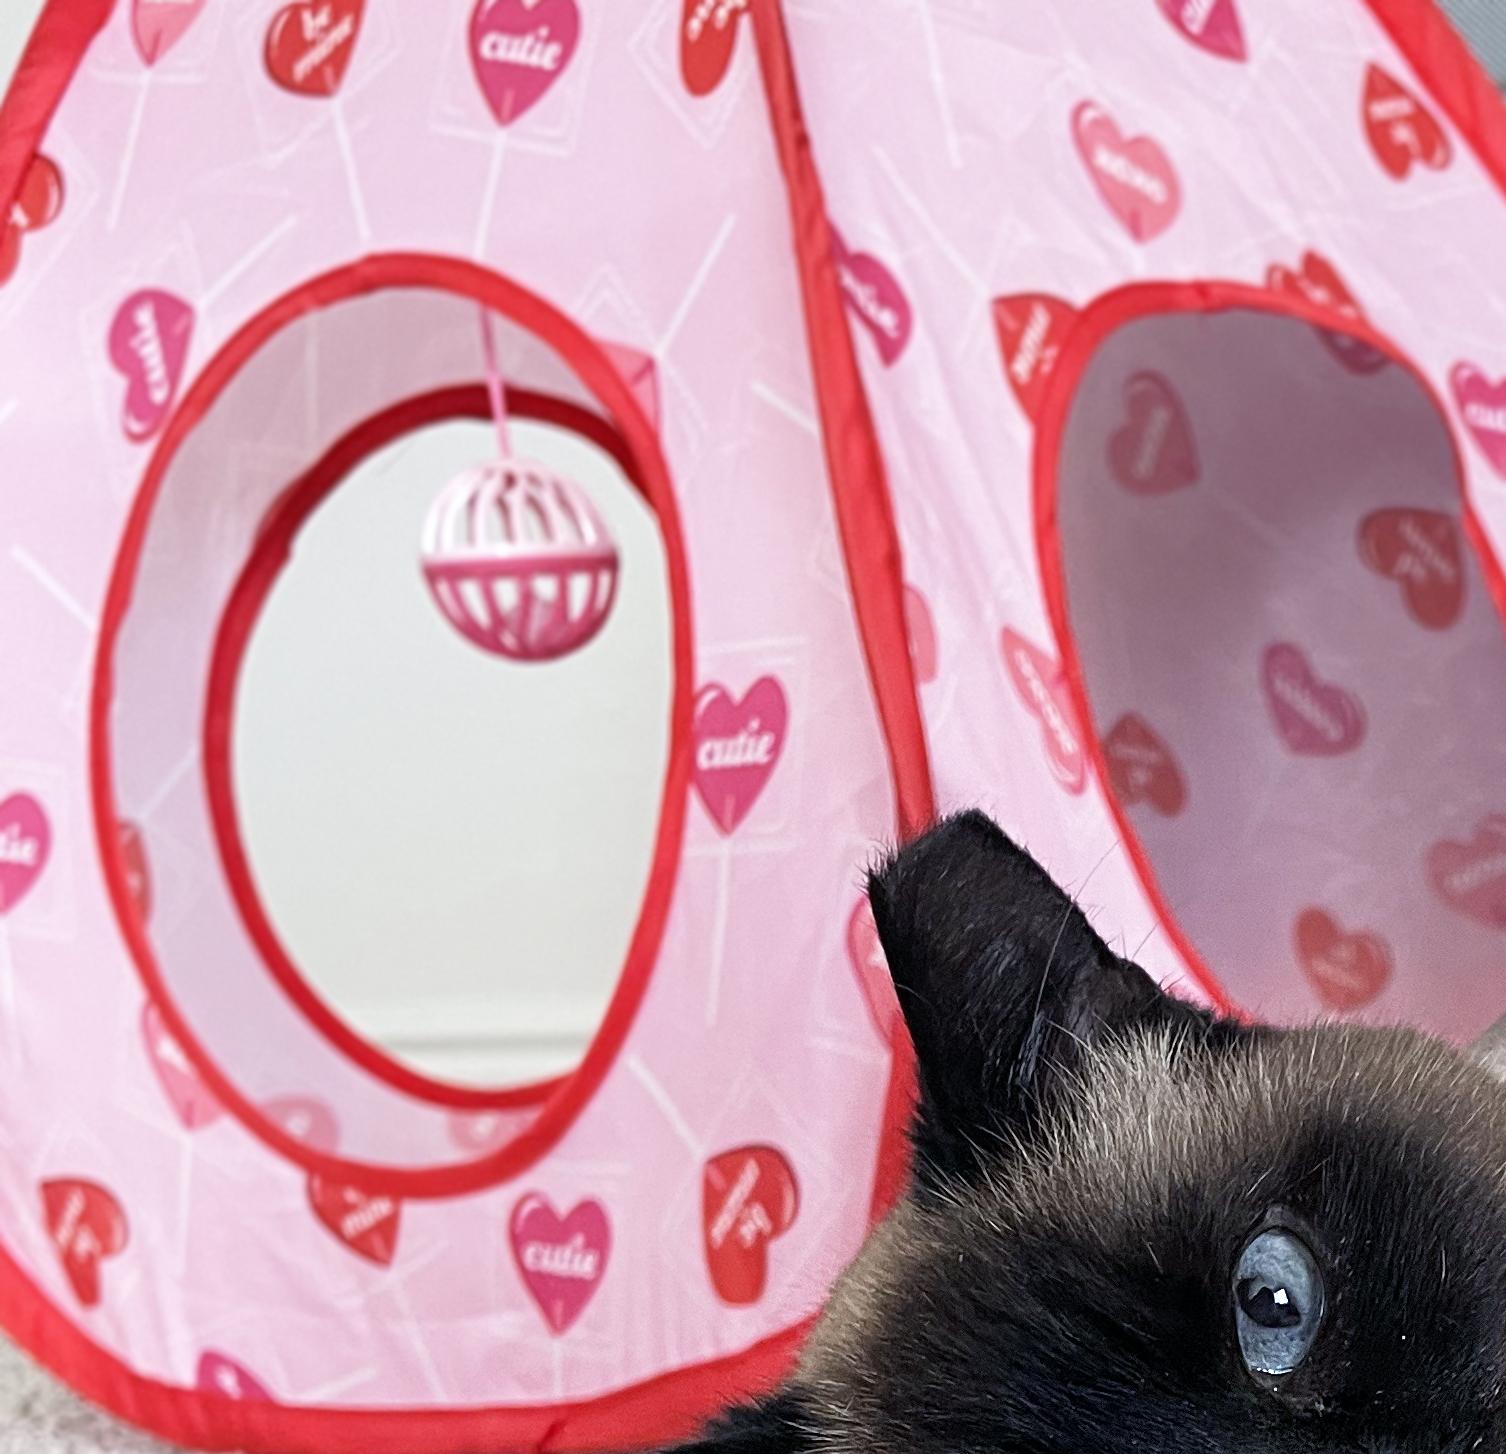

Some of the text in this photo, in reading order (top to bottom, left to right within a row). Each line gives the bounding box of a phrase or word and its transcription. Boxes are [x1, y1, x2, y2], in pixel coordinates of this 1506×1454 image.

[479, 25, 564, 71] cutie
[696, 715, 776, 771] cutie
[521, 1231, 601, 1281] cutie
